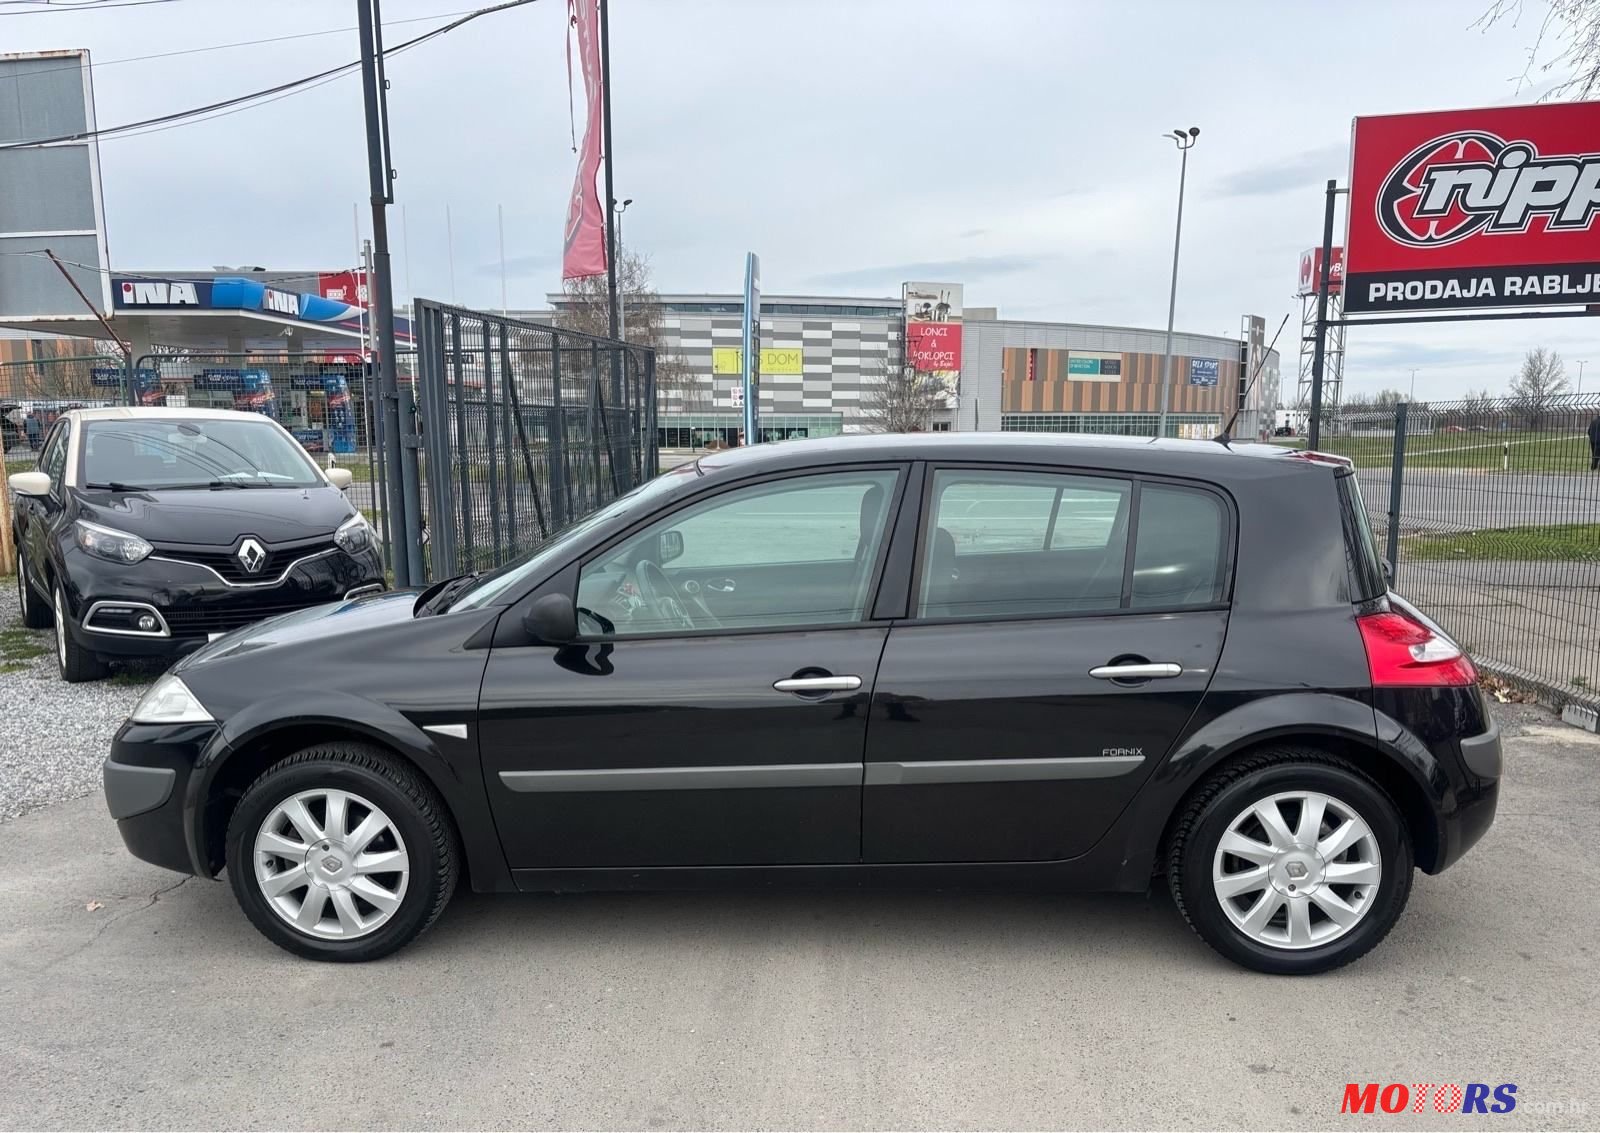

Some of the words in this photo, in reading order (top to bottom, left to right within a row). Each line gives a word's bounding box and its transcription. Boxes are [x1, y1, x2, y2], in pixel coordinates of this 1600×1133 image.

[1369, 277, 1496, 302] PRODAJA
[920, 327, 948, 336] LONCI
[767, 353, 799, 365] DOM
[1103, 747, 1143, 756] FORNIX
